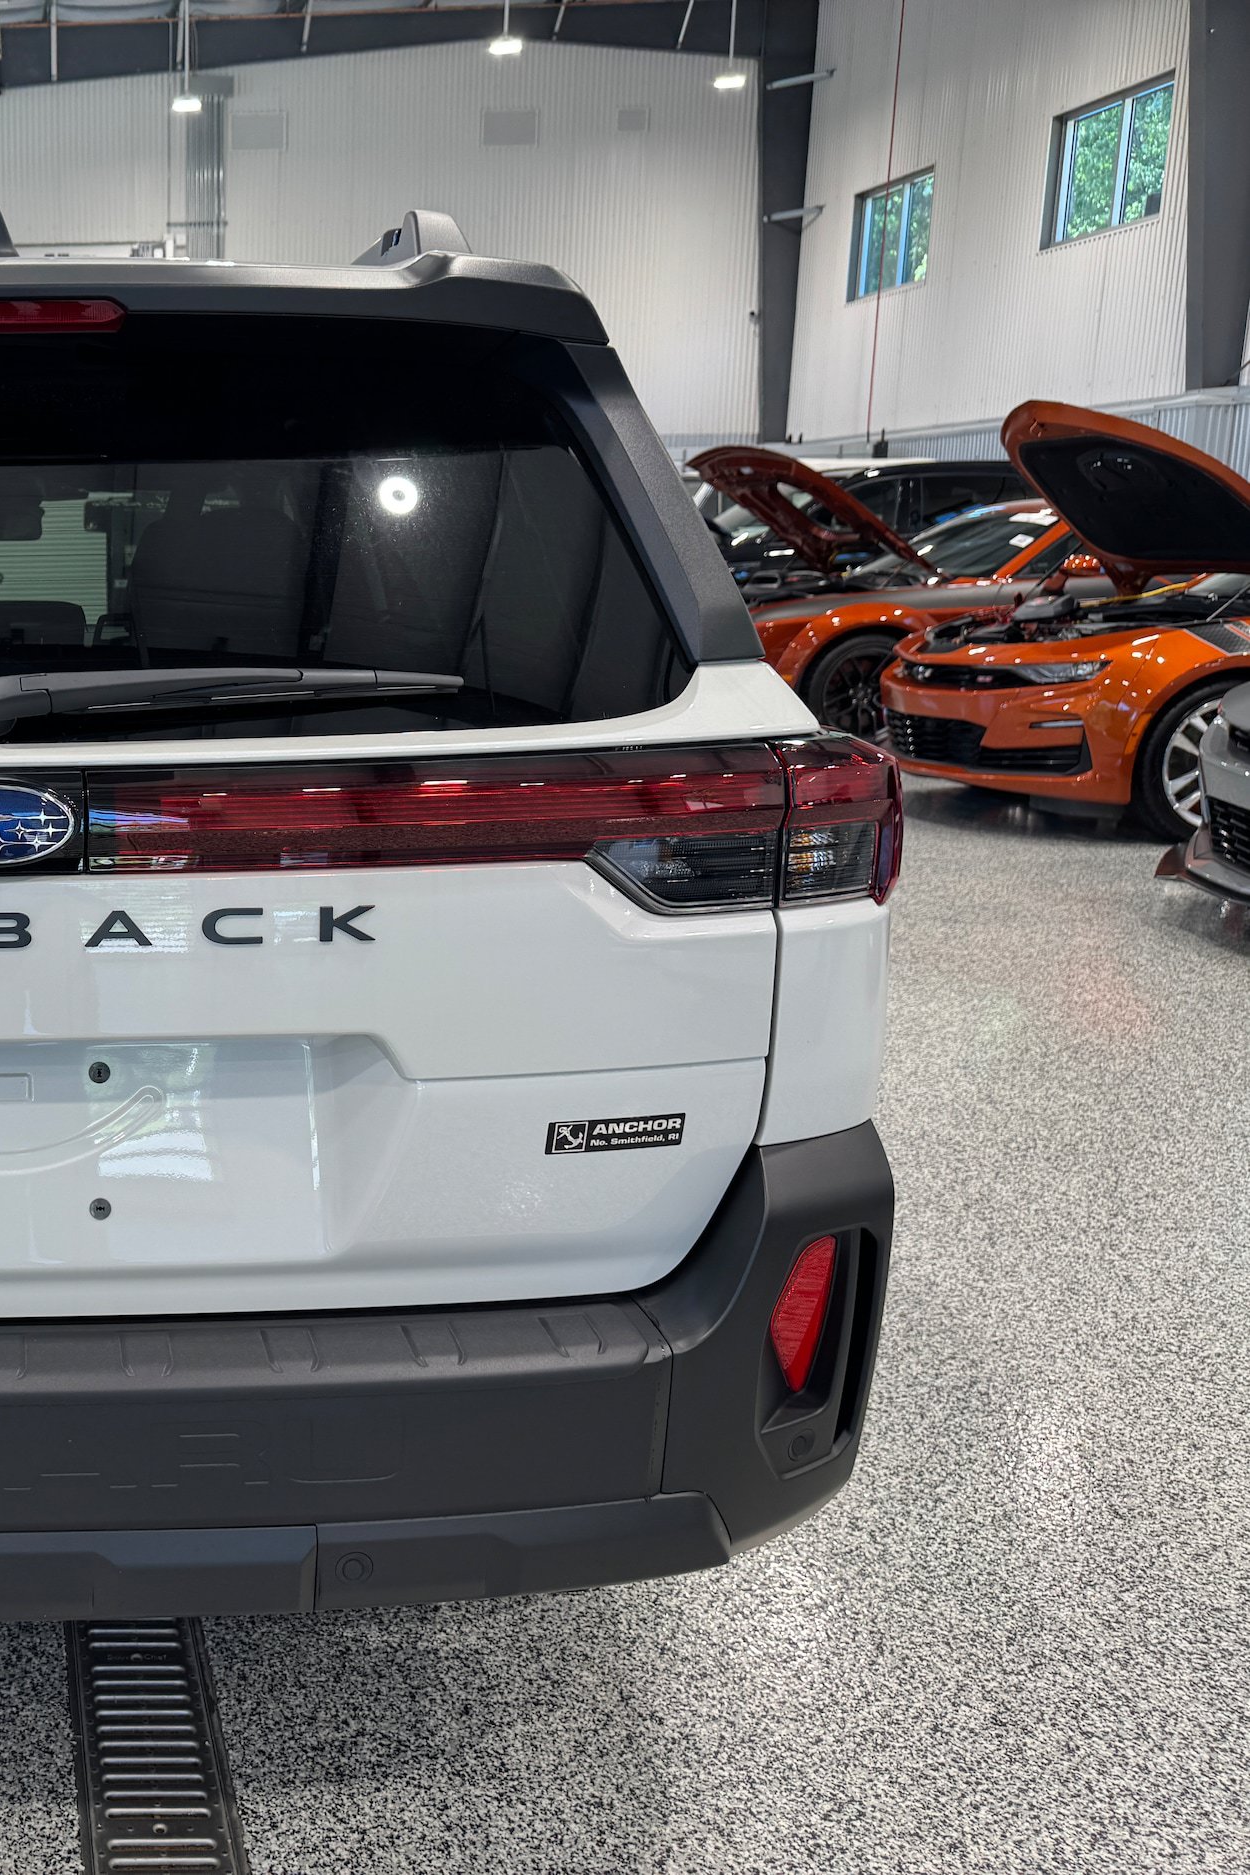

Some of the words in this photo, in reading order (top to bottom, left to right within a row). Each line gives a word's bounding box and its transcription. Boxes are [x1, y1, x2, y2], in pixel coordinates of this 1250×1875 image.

[592, 1117, 682, 1136] ANCHOR
[590, 1139, 608, 1147] No.
[610, 1133, 665, 1145] Smithfield,
[668, 1132, 680, 1141] RI
